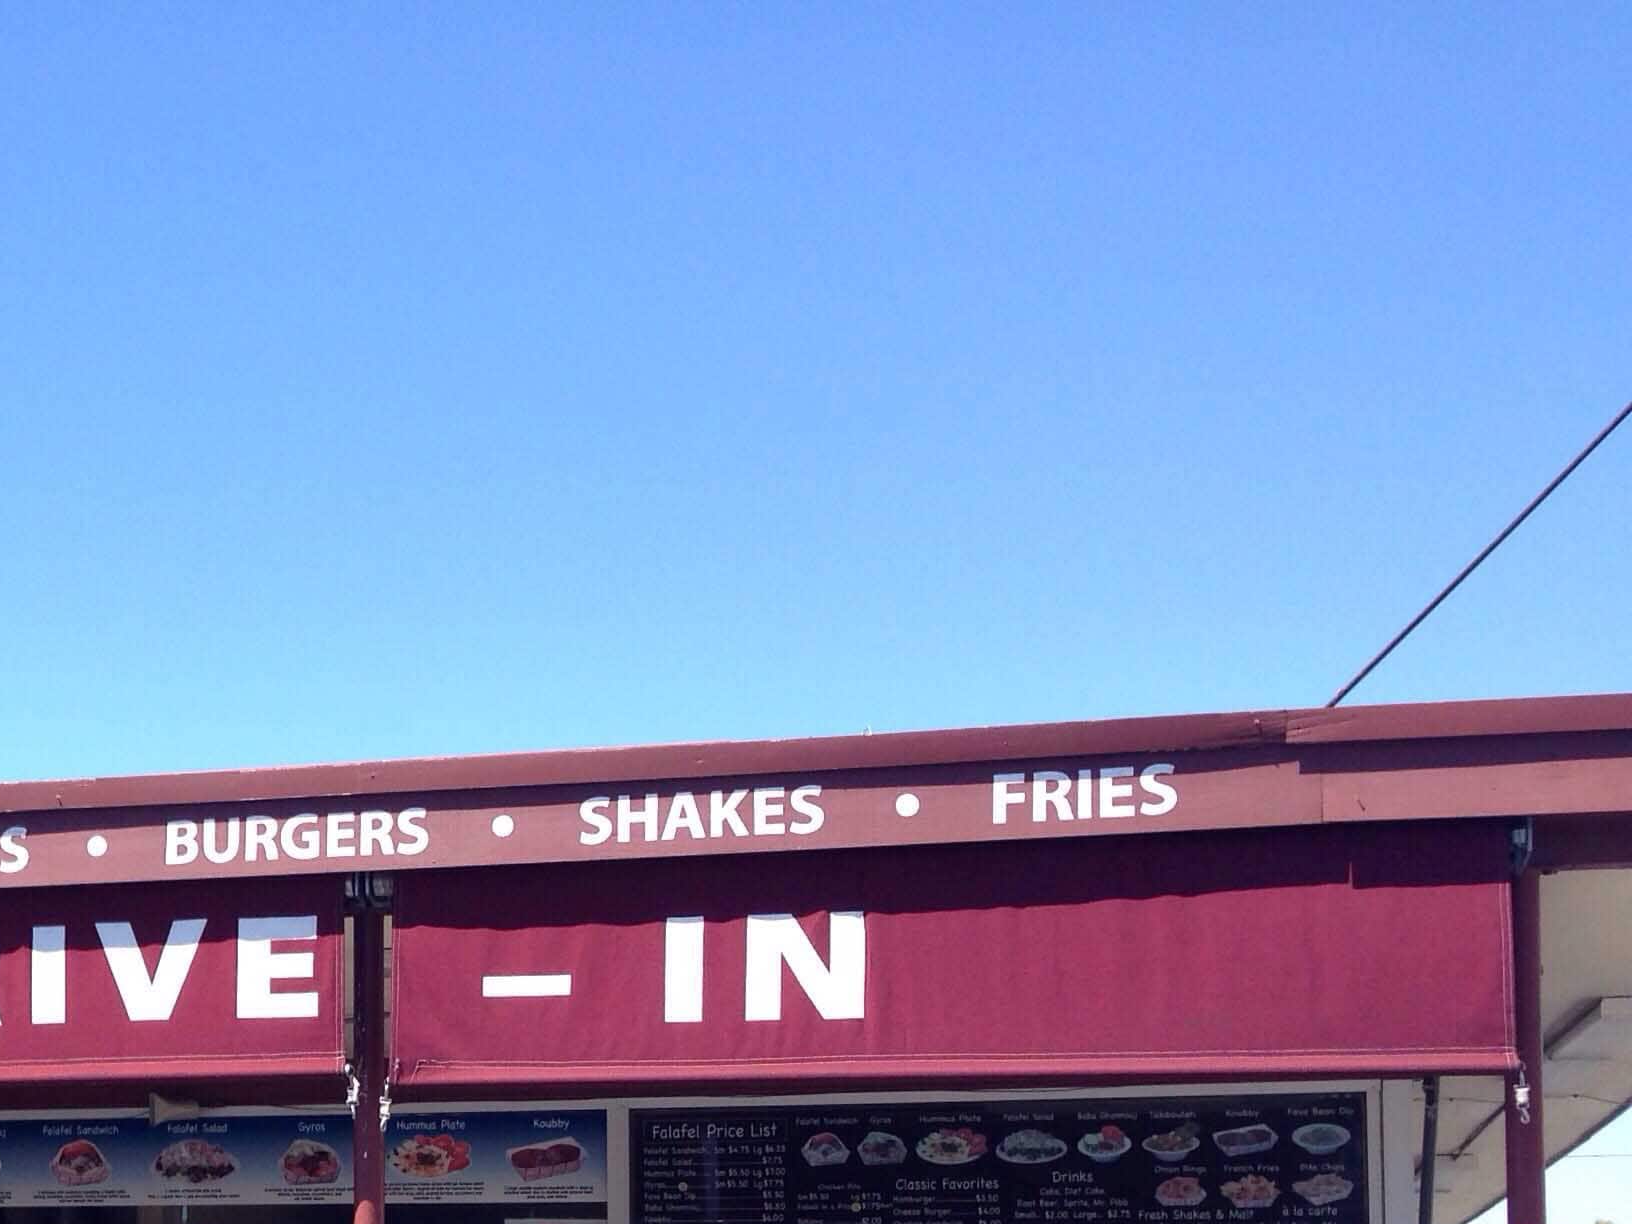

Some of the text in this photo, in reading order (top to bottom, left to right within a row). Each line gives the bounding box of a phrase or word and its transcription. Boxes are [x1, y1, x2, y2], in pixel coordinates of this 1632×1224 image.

[165, 807, 431, 870] BURGERS
[578, 785, 825, 846] SHAKES
[991, 763, 1178, 825] FRIES
[664, 911, 866, 1024] IN
[43, 1125, 119, 1136] Falafel Sandwich
[167, 1123, 228, 1134] Falafel Salad
[297, 1122, 326, 1133] Gyros
[397, 1120, 467, 1131] Hummus Plate
[653, 1121, 777, 1139] Falafel Price List
[1051, 1169, 1095, 1184] Drinks
[895, 1177, 1000, 1191] Classic Favorites
[1138, 1208, 1169, 1221] Fresh
[1172, 1208, 1211, 1221] Shakes
[1308, 1204, 1338, 1217] carte
